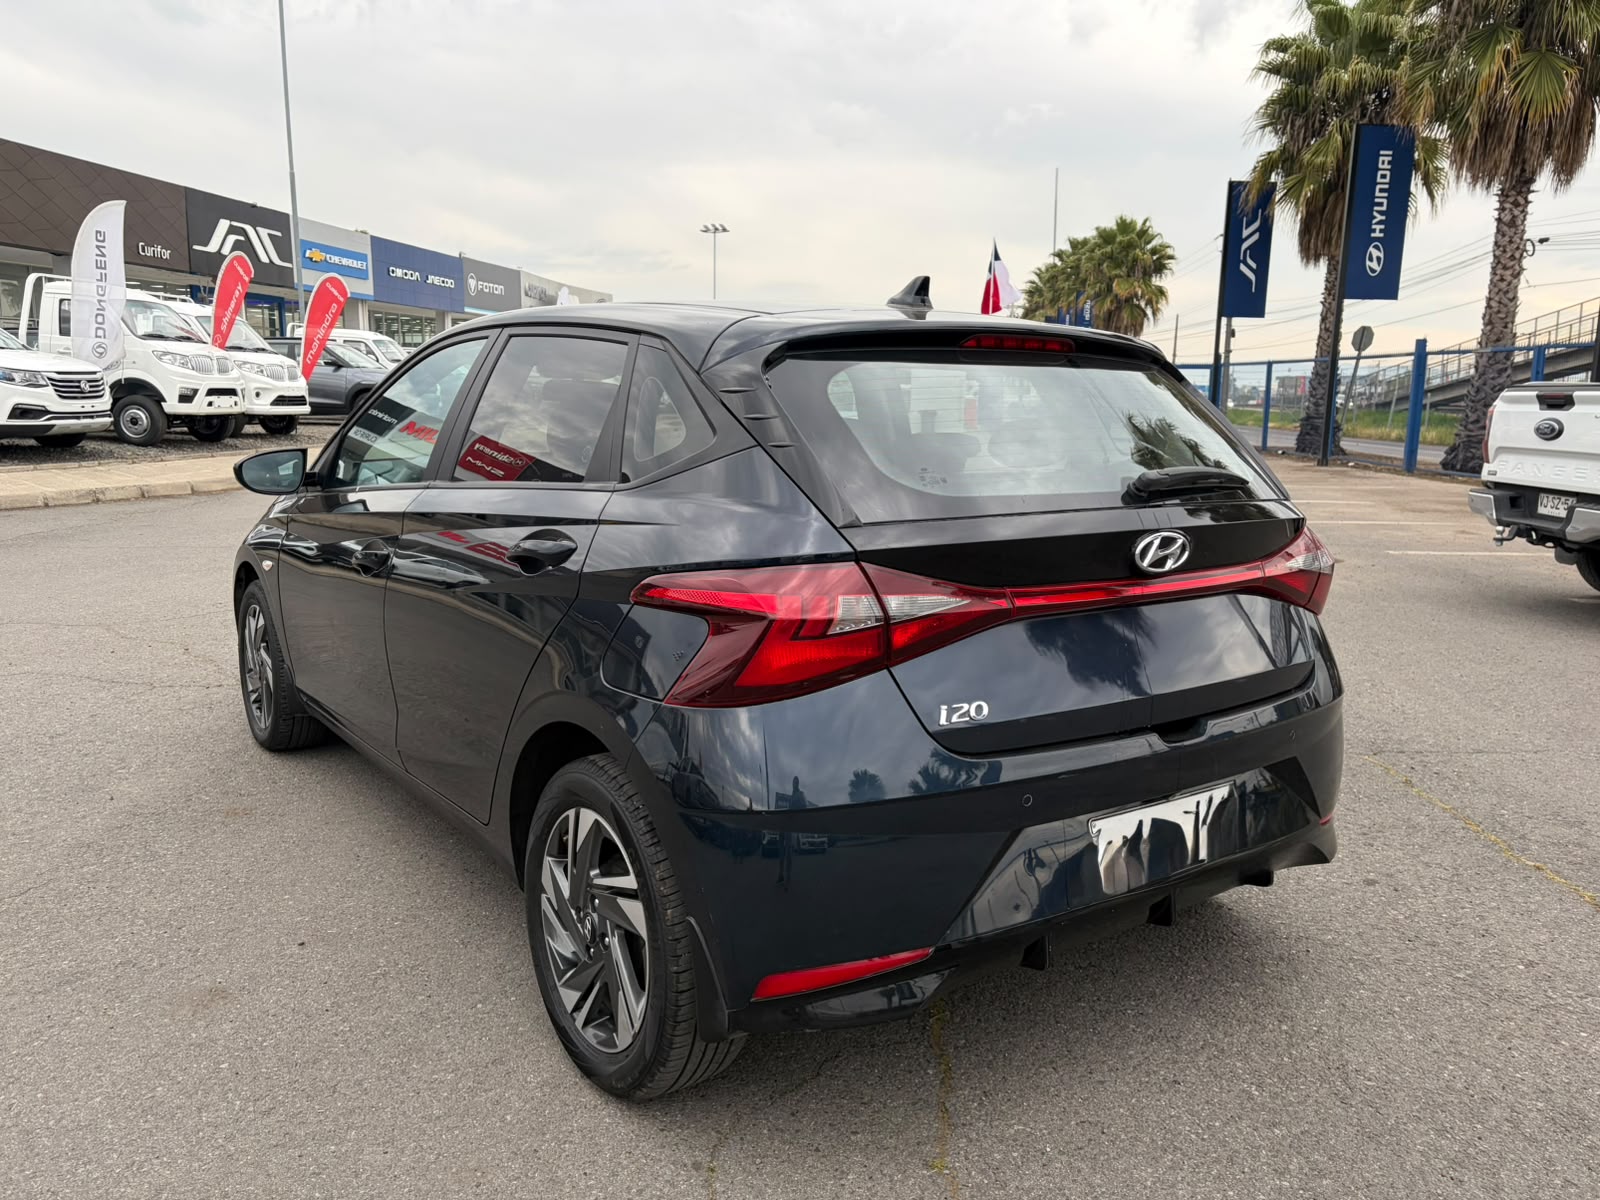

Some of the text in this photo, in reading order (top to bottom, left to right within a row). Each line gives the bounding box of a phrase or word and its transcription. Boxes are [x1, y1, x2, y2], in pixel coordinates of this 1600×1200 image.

[1371, 150, 1393, 237] HYUNDAI
[138, 242, 171, 260] Curifor
[192, 219, 293, 268] JAC
[1239, 208, 1262, 293] JAC
[326, 256, 367, 270] CHEVROLET
[389, 266, 455, 288] OMODA JAECOO
[478, 281, 505, 295] FOTON
[306, 303, 338, 364] mahindra
[938, 701, 989, 726] i20
